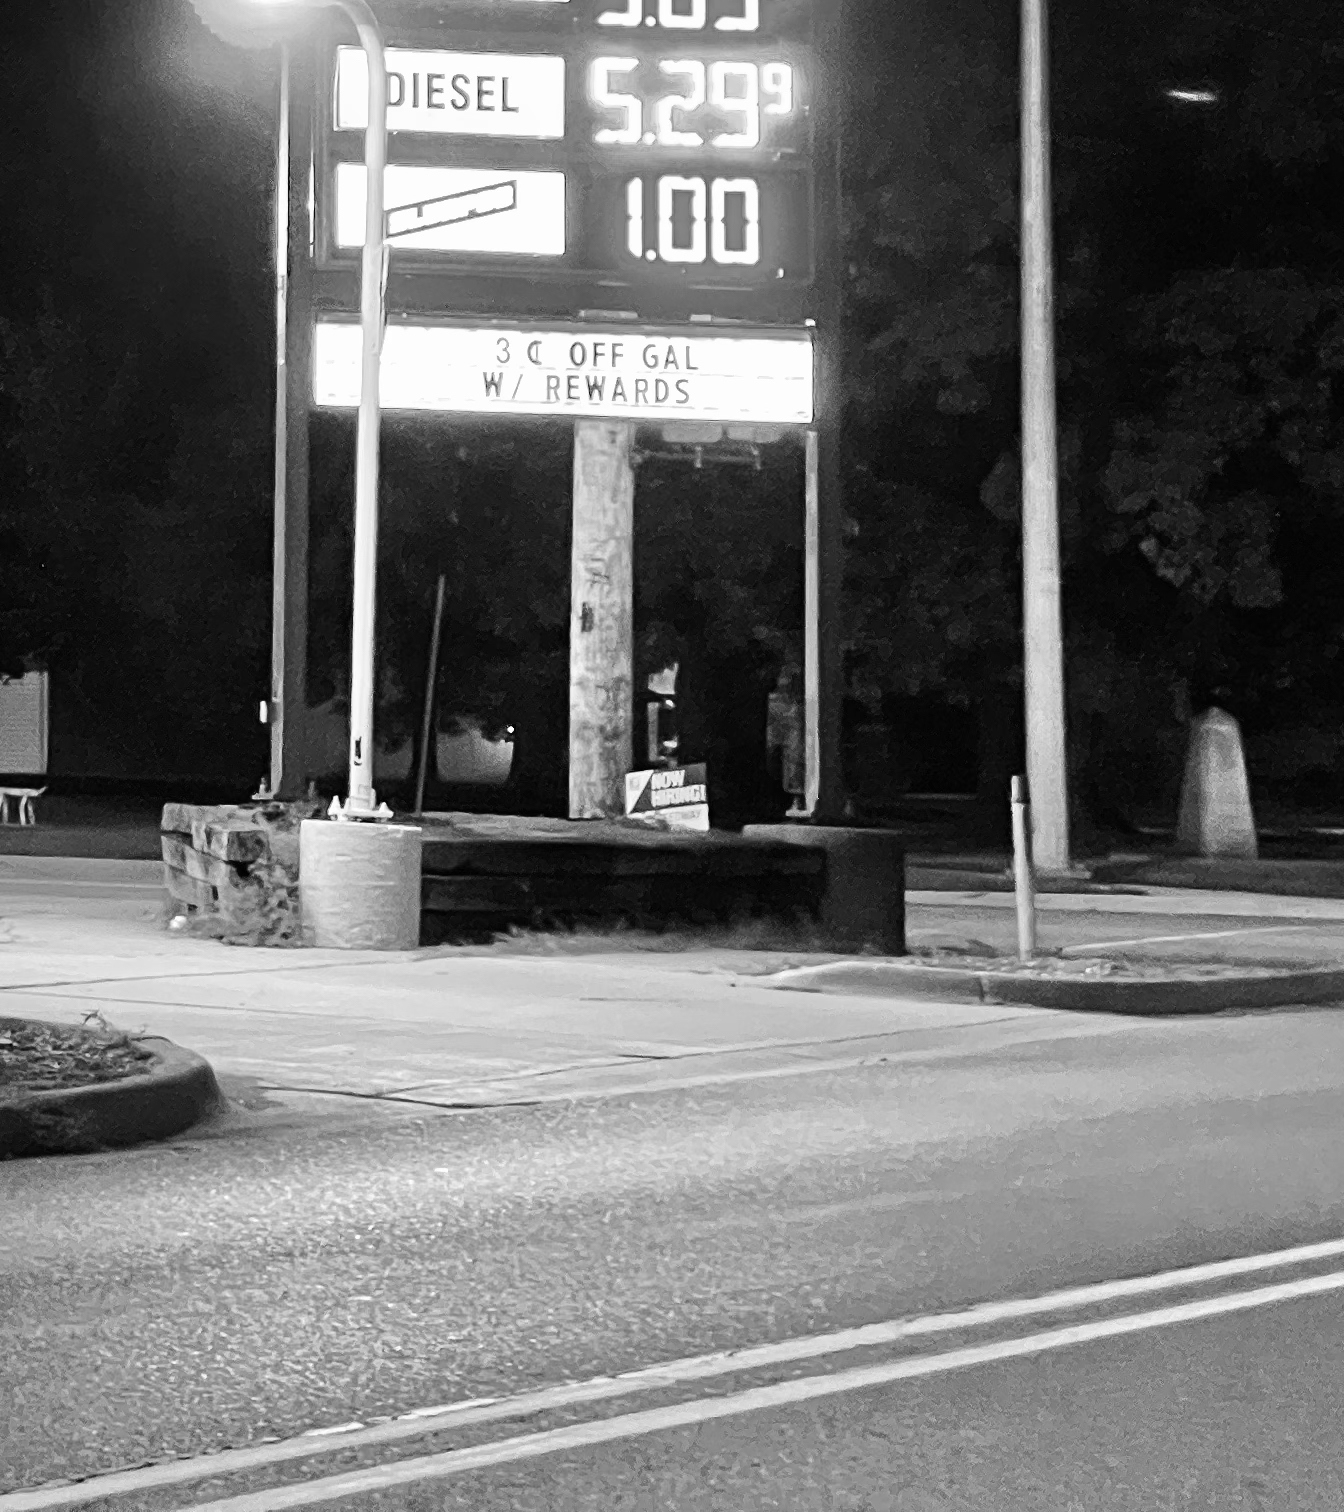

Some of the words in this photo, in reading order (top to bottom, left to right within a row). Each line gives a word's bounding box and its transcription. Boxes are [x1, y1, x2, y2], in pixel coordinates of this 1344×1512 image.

[387, 71, 520, 114] DIESEL
[626, 175, 760, 266] 1.00
[496, 336, 511, 364] 3
[568, 340, 625, 368] OFF
[641, 343, 699, 371] GAL
[545, 374, 691, 405] REWARDS
